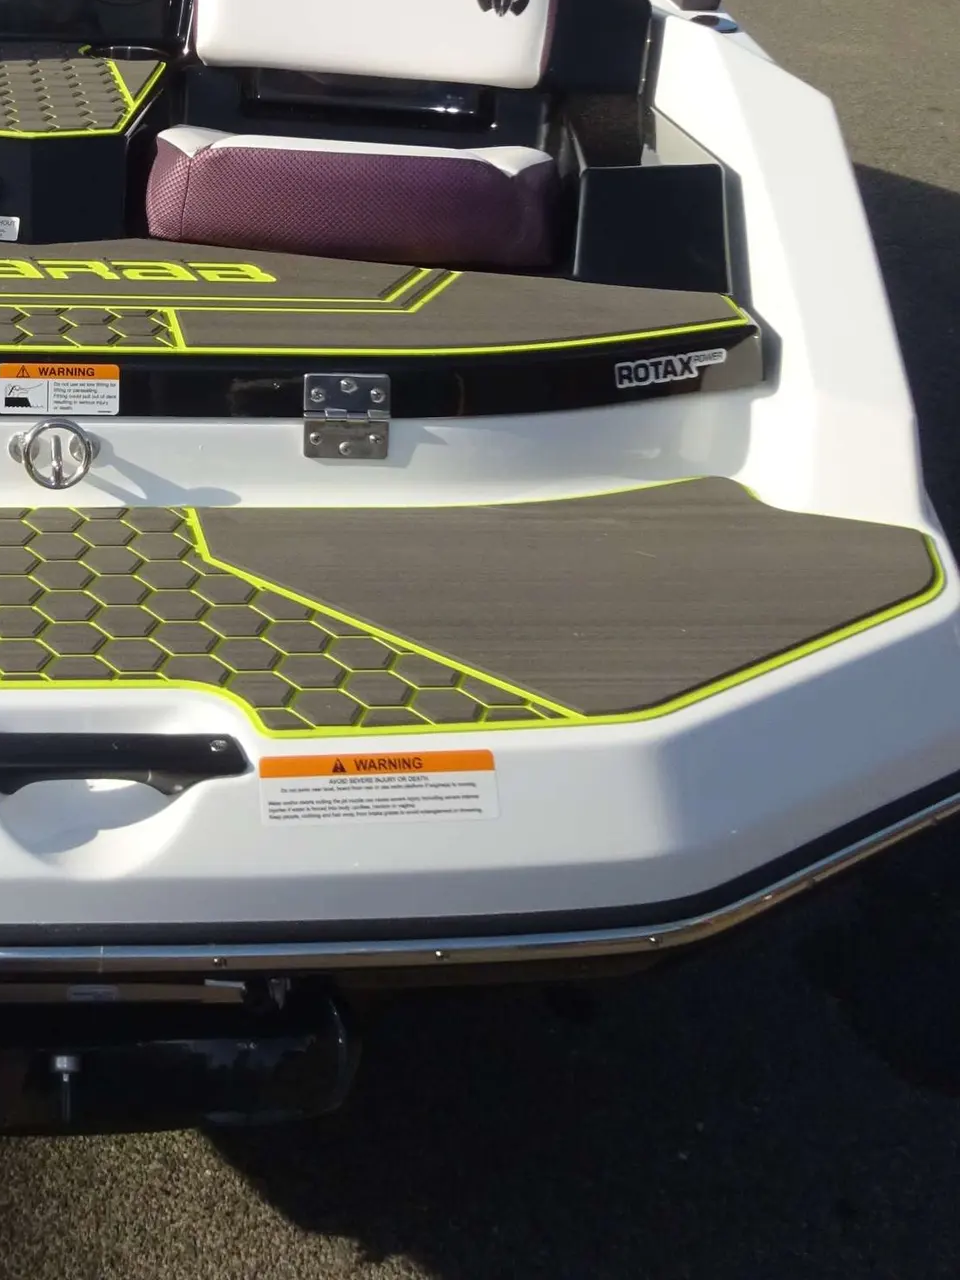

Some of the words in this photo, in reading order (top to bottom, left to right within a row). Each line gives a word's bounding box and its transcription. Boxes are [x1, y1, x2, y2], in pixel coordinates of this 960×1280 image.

[38, 367, 95, 377] WARNING
[617, 356, 694, 385] ROTAX
[354, 757, 423, 772] WARNING
